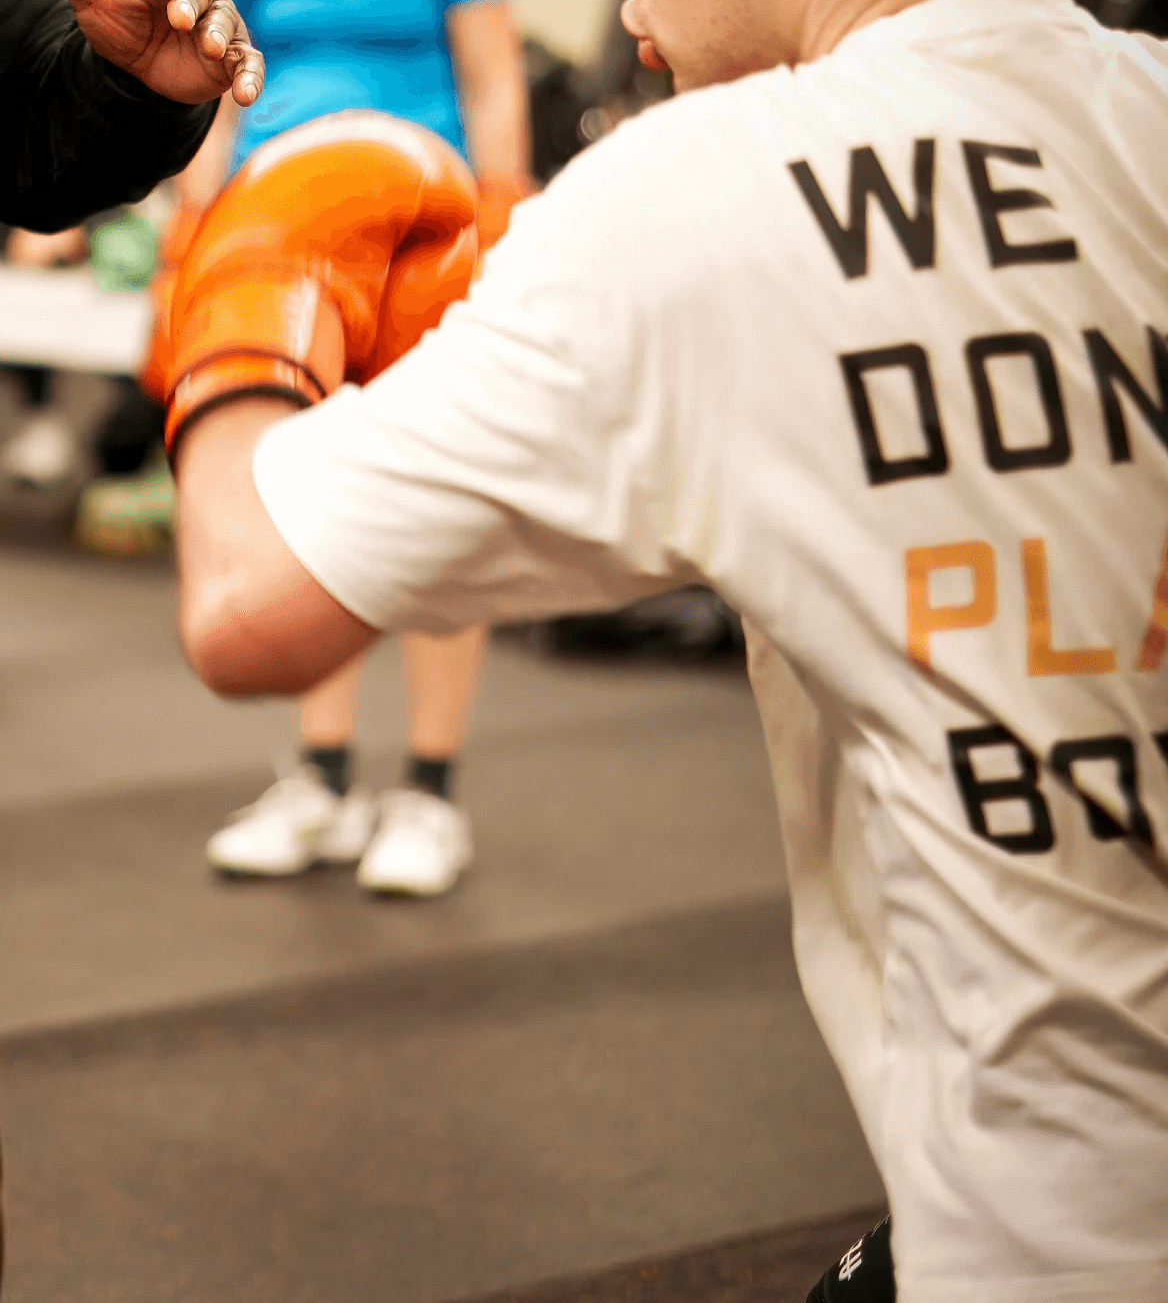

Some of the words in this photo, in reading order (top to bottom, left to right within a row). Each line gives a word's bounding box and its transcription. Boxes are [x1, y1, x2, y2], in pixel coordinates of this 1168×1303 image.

[787, 137, 1080, 282] WE
[903, 522, 1168, 679] PL
[946, 722, 1168, 856] BO
